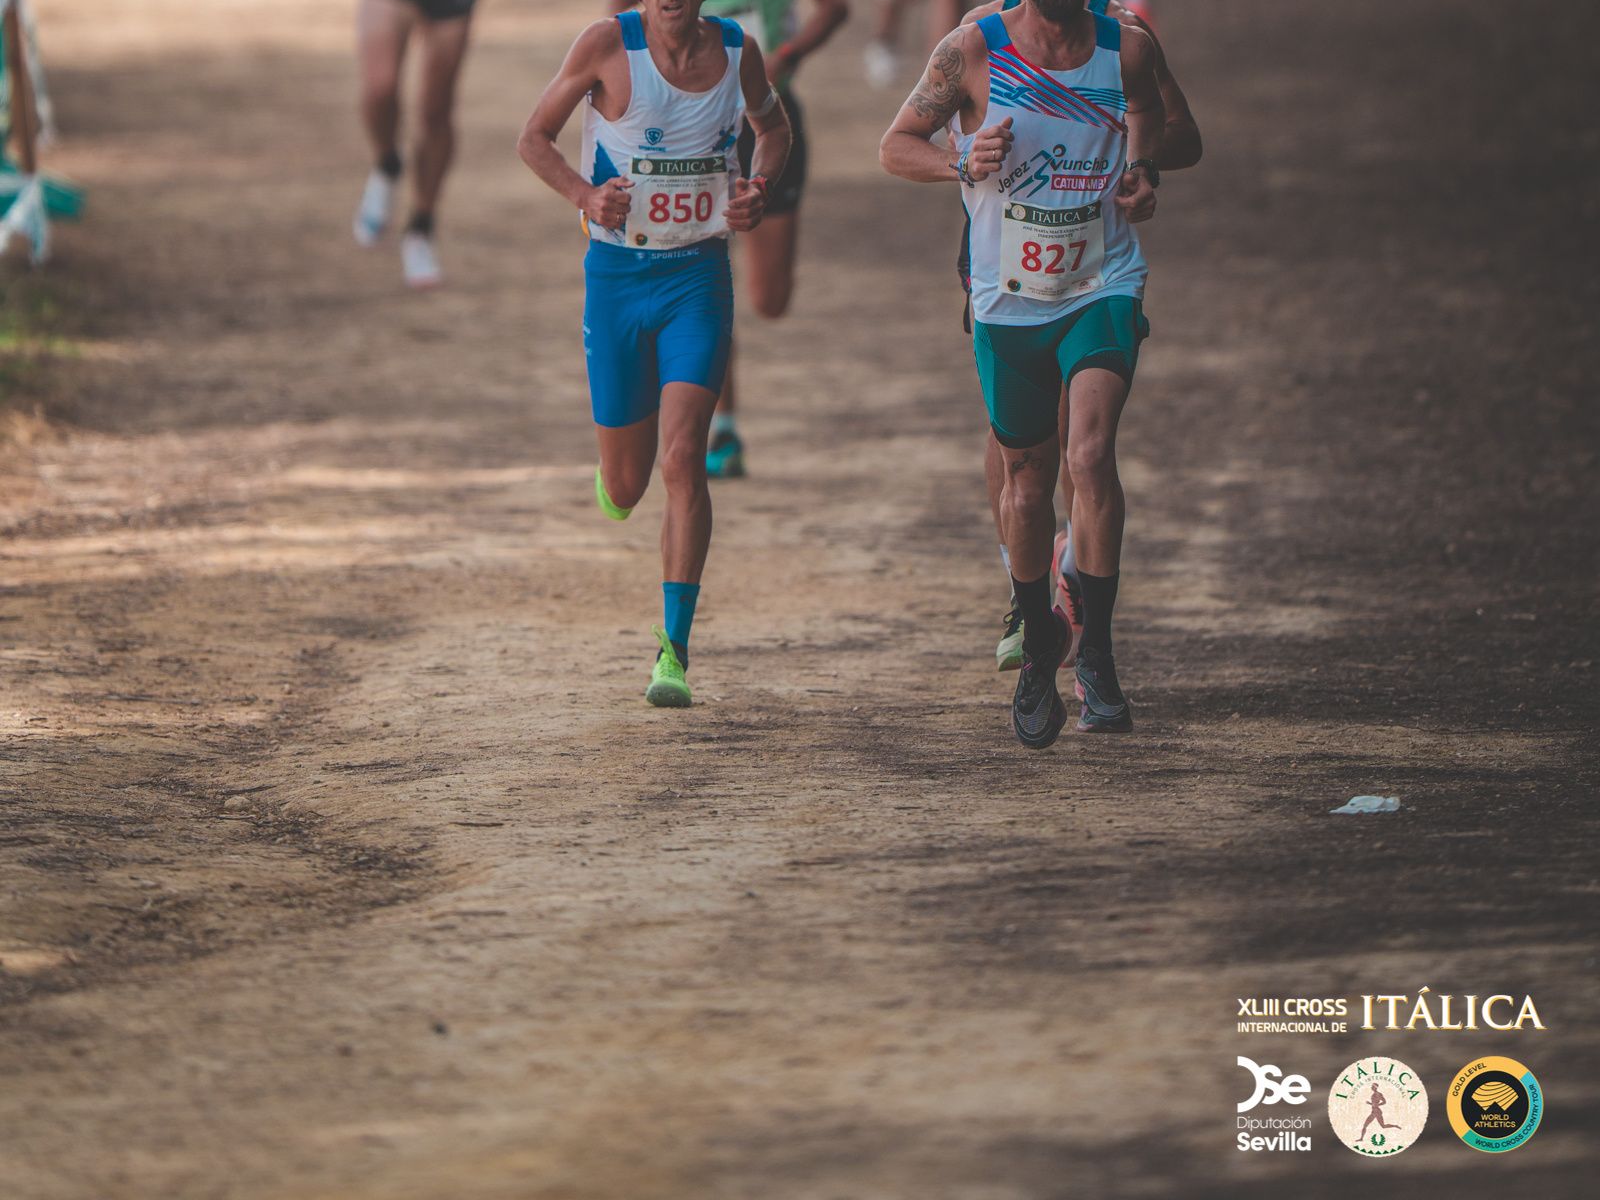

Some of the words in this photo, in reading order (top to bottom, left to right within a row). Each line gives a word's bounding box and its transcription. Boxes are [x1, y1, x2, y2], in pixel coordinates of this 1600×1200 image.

[660, 159, 706, 172] ITÁLICA
[998, 161, 1031, 193] Jerez
[1053, 176, 1107, 190] CATUNAMB
[648, 191, 713, 224] 850
[1032, 210, 1080, 224] ITÁLICA
[1021, 240, 1088, 275] 827
